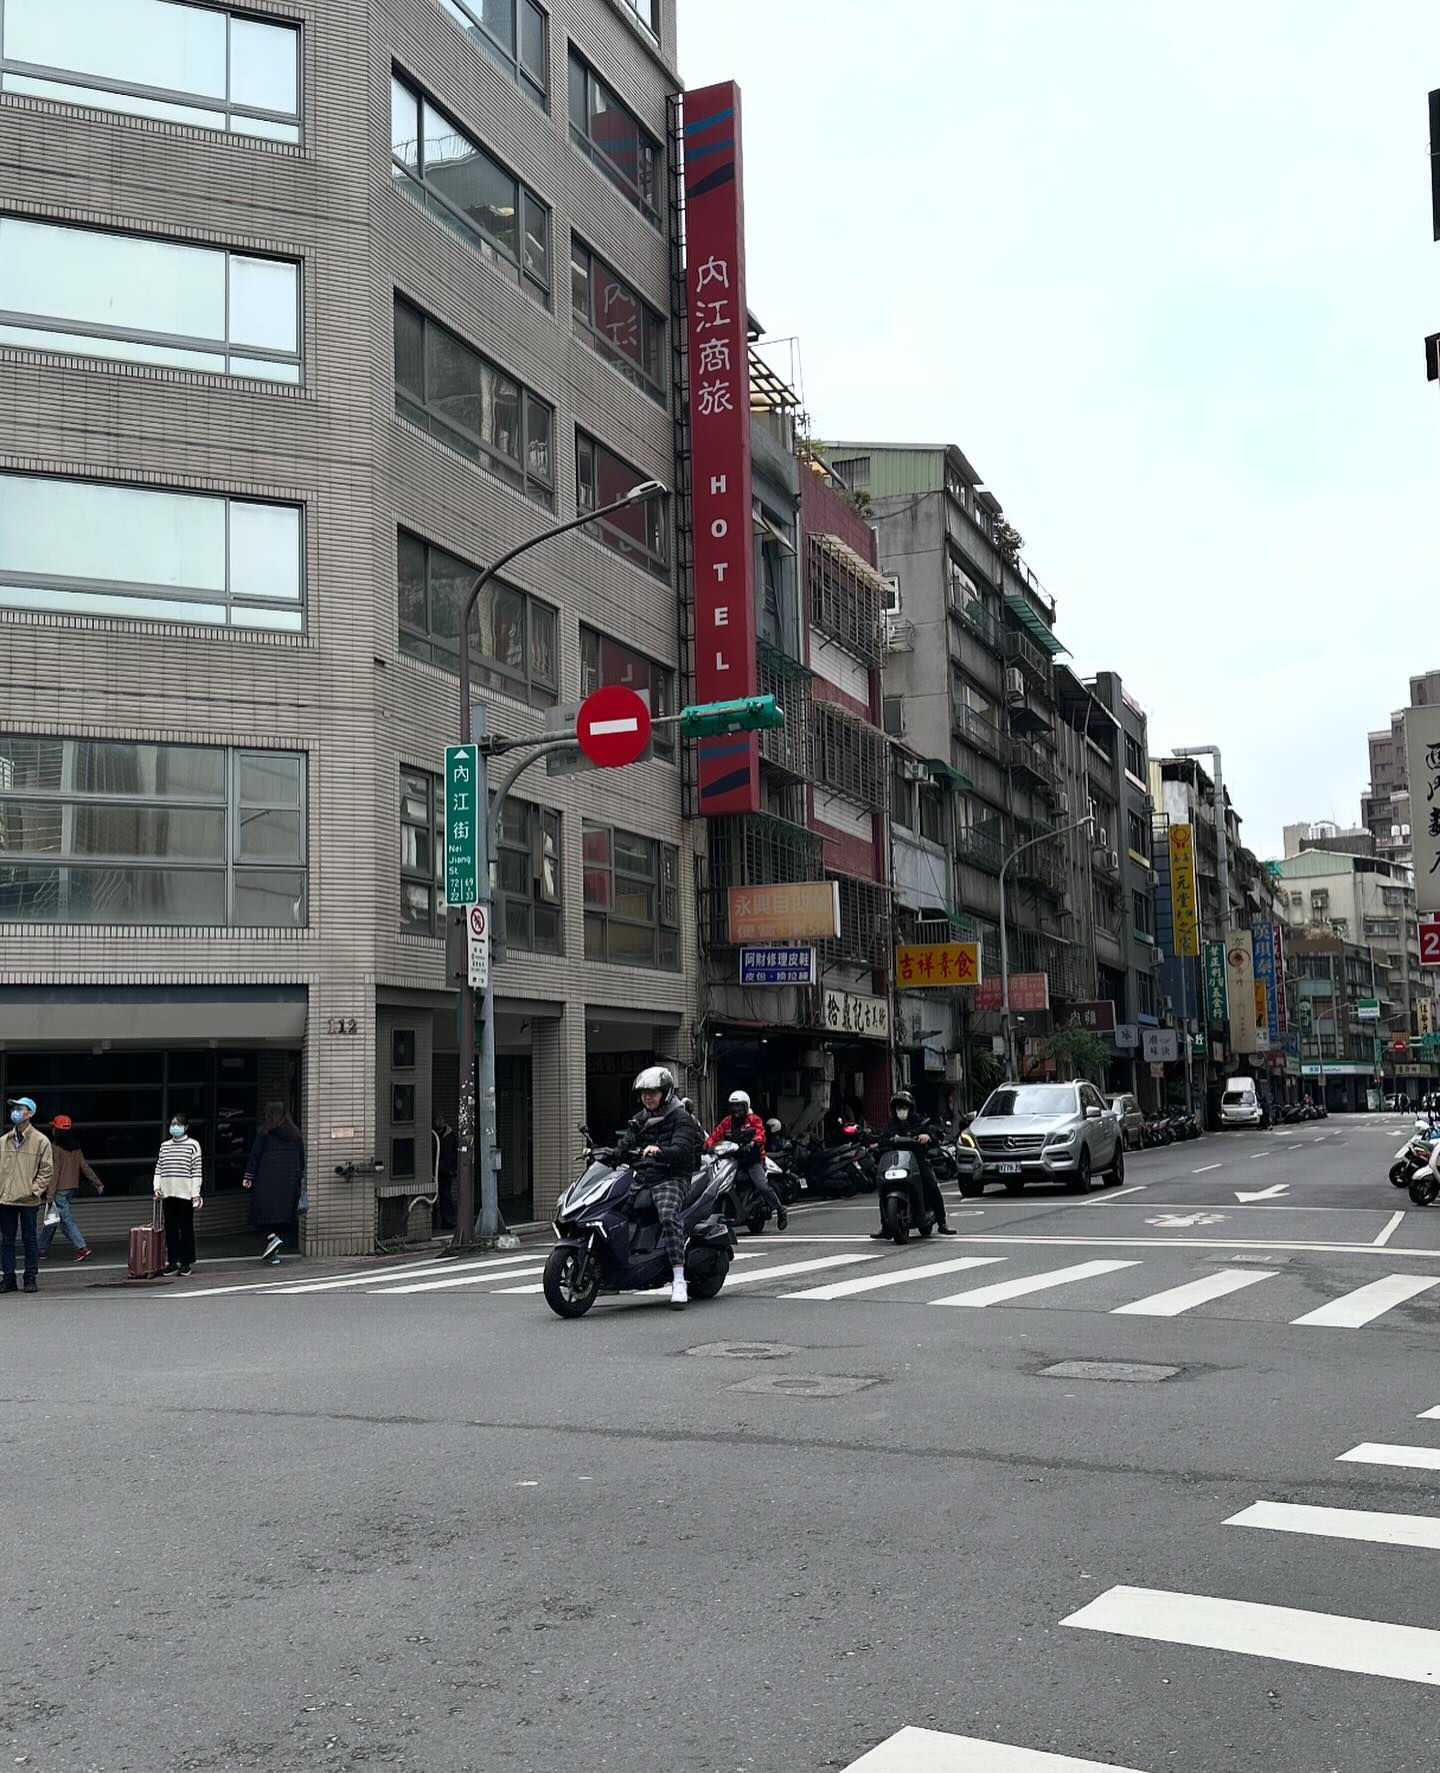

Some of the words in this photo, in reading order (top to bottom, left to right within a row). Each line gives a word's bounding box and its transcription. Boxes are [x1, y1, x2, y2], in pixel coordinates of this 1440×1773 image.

[710, 474, 730, 671] HOTEL
[453, 765, 470, 840] 內江街
[448, 844, 462, 854] Nei
[448, 855, 471, 867] Jiang
[744, 951, 809, 968] 阿財修理皮鞋
[900, 950, 974, 980] 吉祥素食
[327, 1018, 358, 1035] 112
